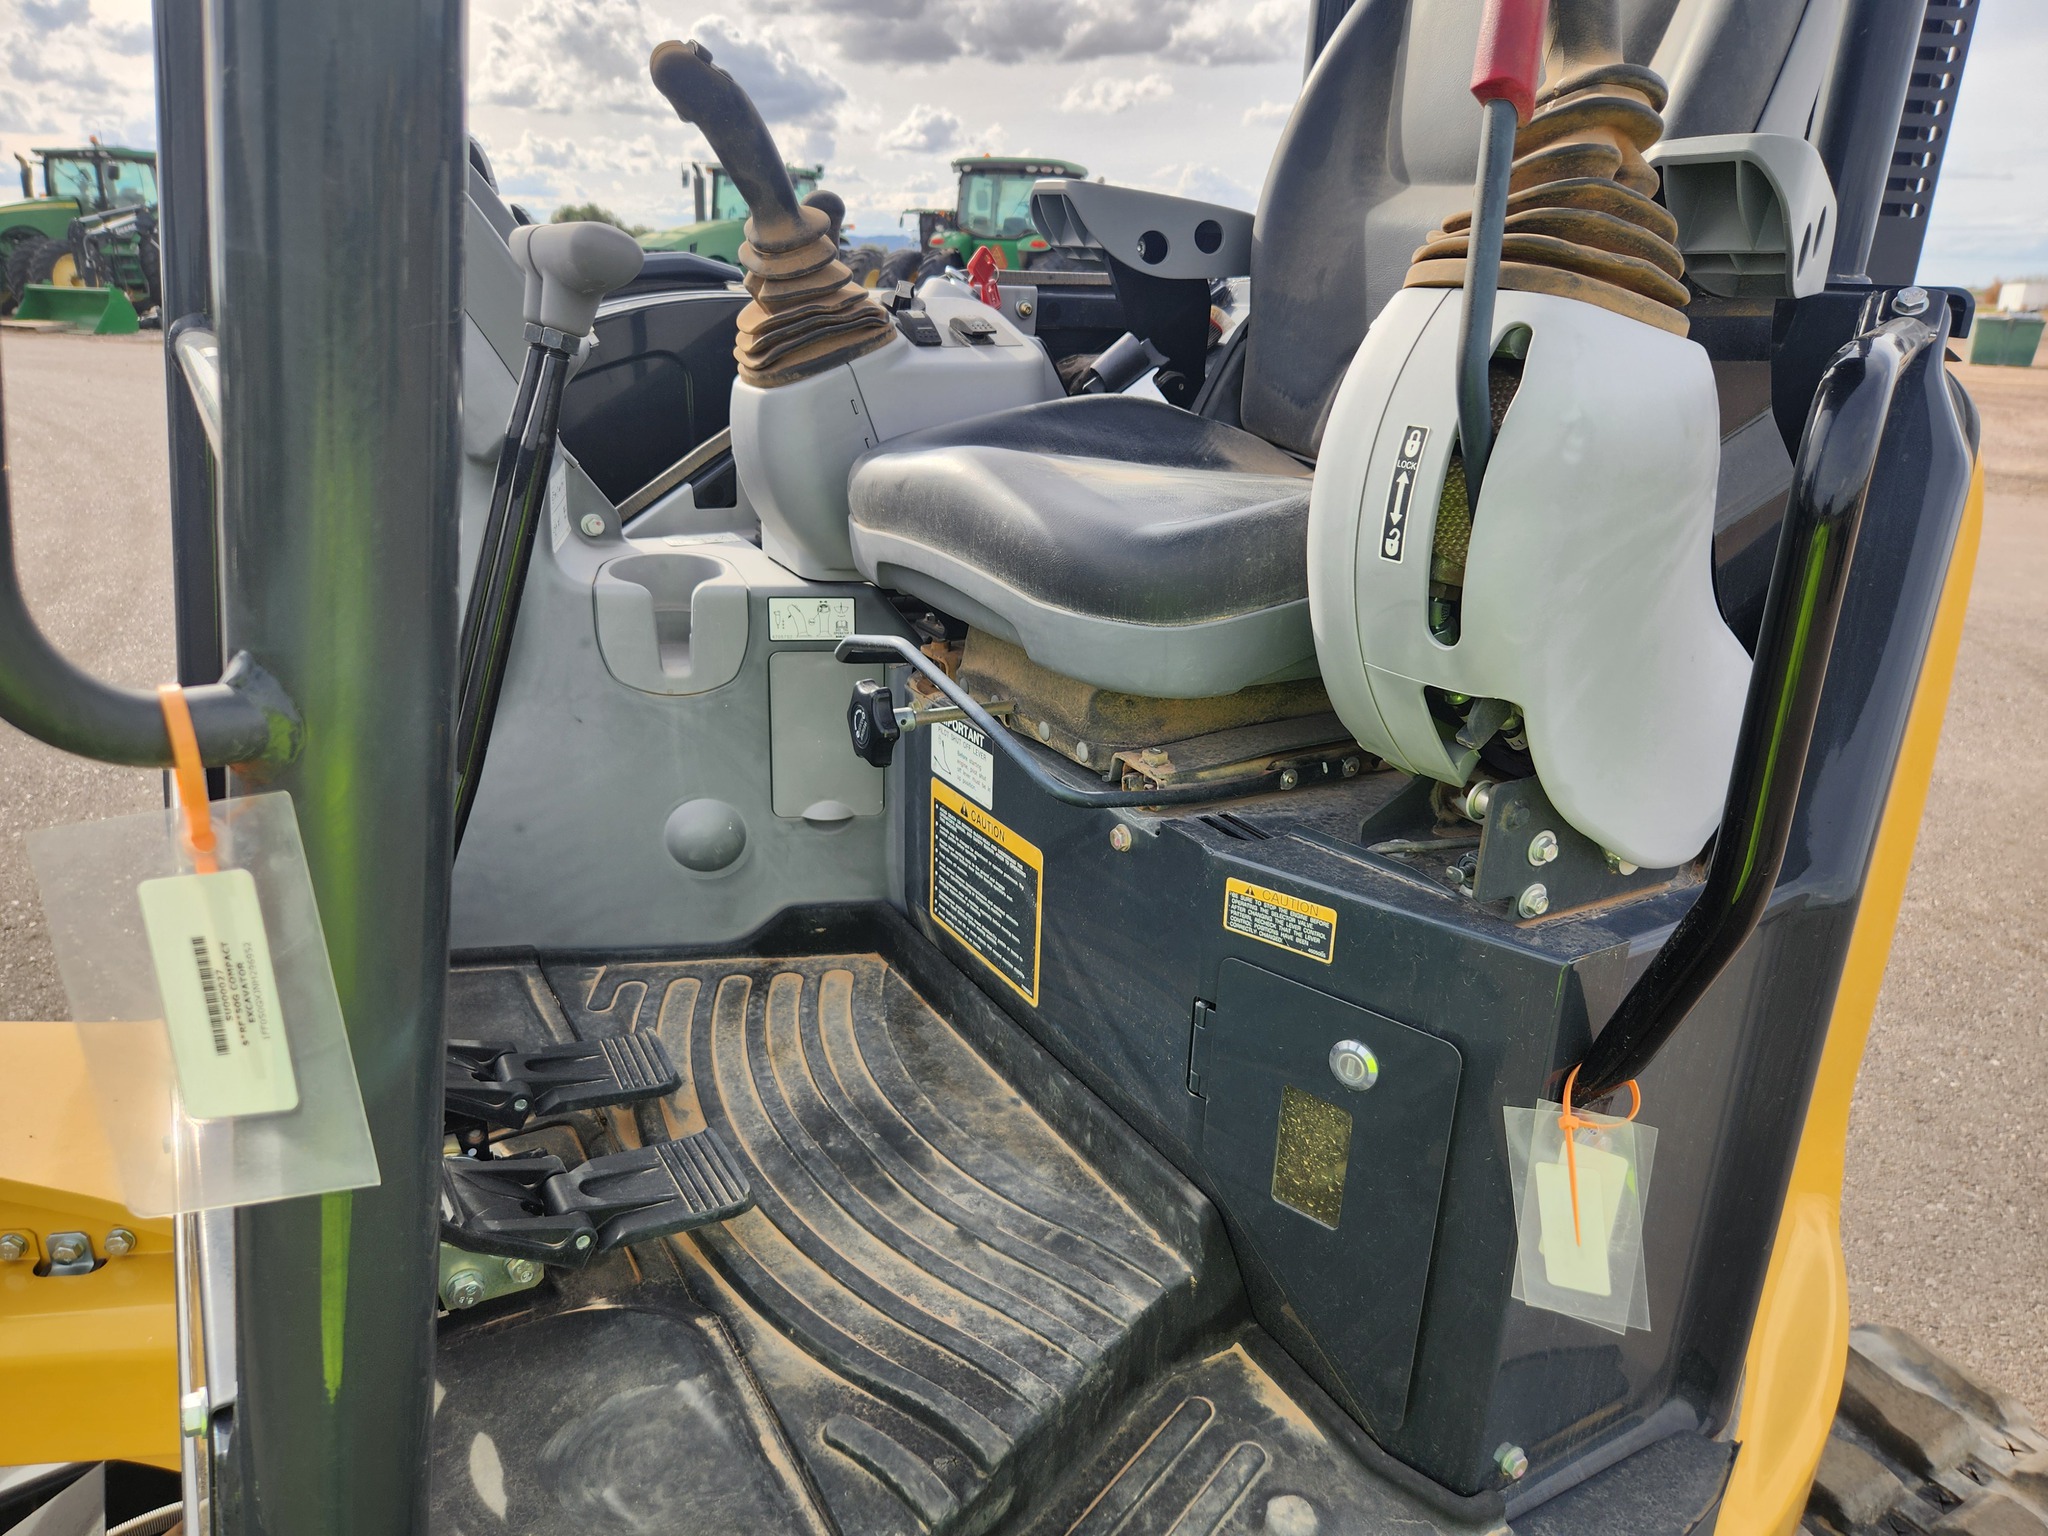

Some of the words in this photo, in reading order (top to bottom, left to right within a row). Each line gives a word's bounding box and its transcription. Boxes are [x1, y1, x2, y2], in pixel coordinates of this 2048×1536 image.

[1397, 460, 1417, 470] LOCK
[942, 720, 984, 747] MPORTANT
[973, 747, 986, 760] LEVER
[971, 810, 1005, 842] CAUTION
[1262, 890, 1319, 916] CAUTION
[221, 942, 238, 990] COMPACT
[216, 970, 233, 1021] SU000027
[237, 962, 256, 1023] EXCAVATOR
